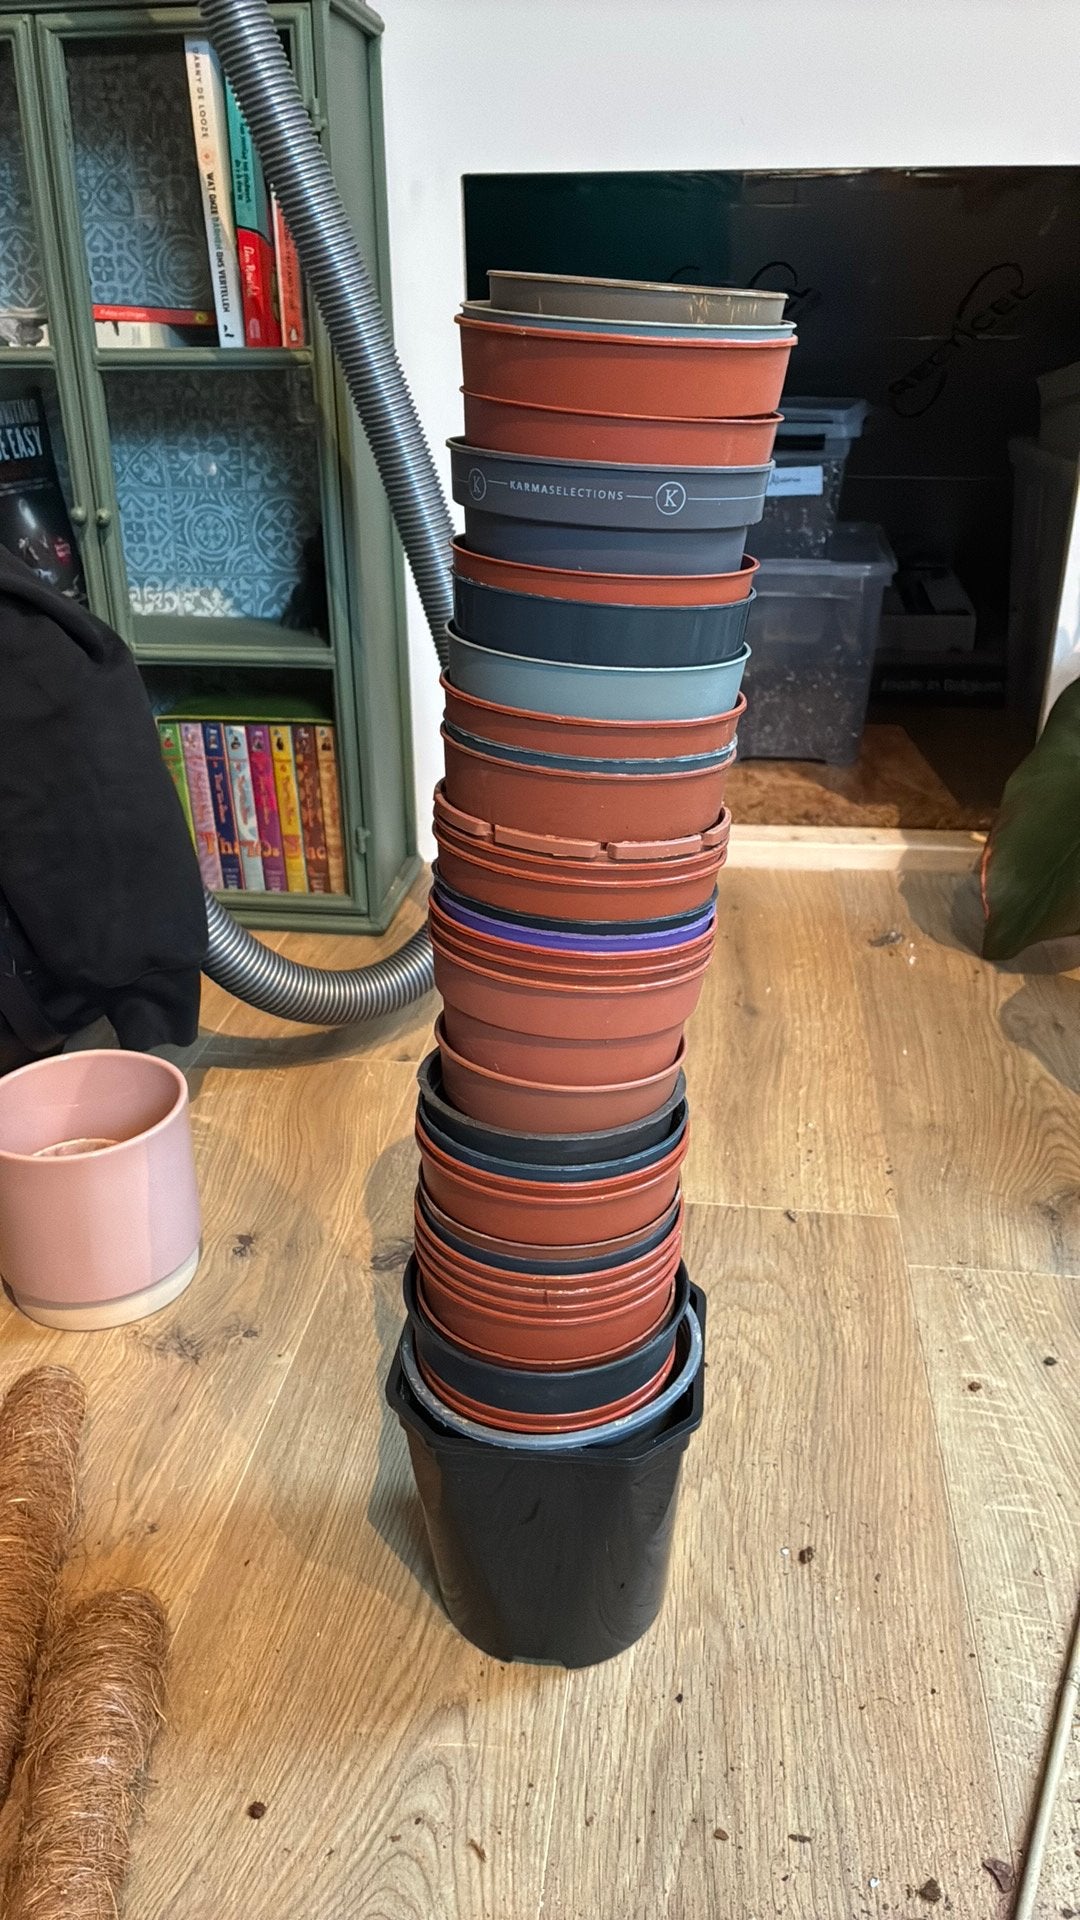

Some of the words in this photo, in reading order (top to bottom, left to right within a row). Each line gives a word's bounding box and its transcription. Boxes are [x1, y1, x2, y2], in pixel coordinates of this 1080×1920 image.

[192, 47, 204, 82] DANNY
[196, 87, 205, 100] DE
[199, 104, 209, 138] LOOZE
[206, 172, 216, 191] WAT
[208, 194, 219, 214] ONZE
[216, 252, 225, 268] ONS
[218, 270, 230, 312] VERTELLEN
[5, 426, 43, 459] EASY
[472, 476, 482, 493] K
[509, 479, 624, 501] KARMASELECTIONS
[664, 489, 677, 508] K
